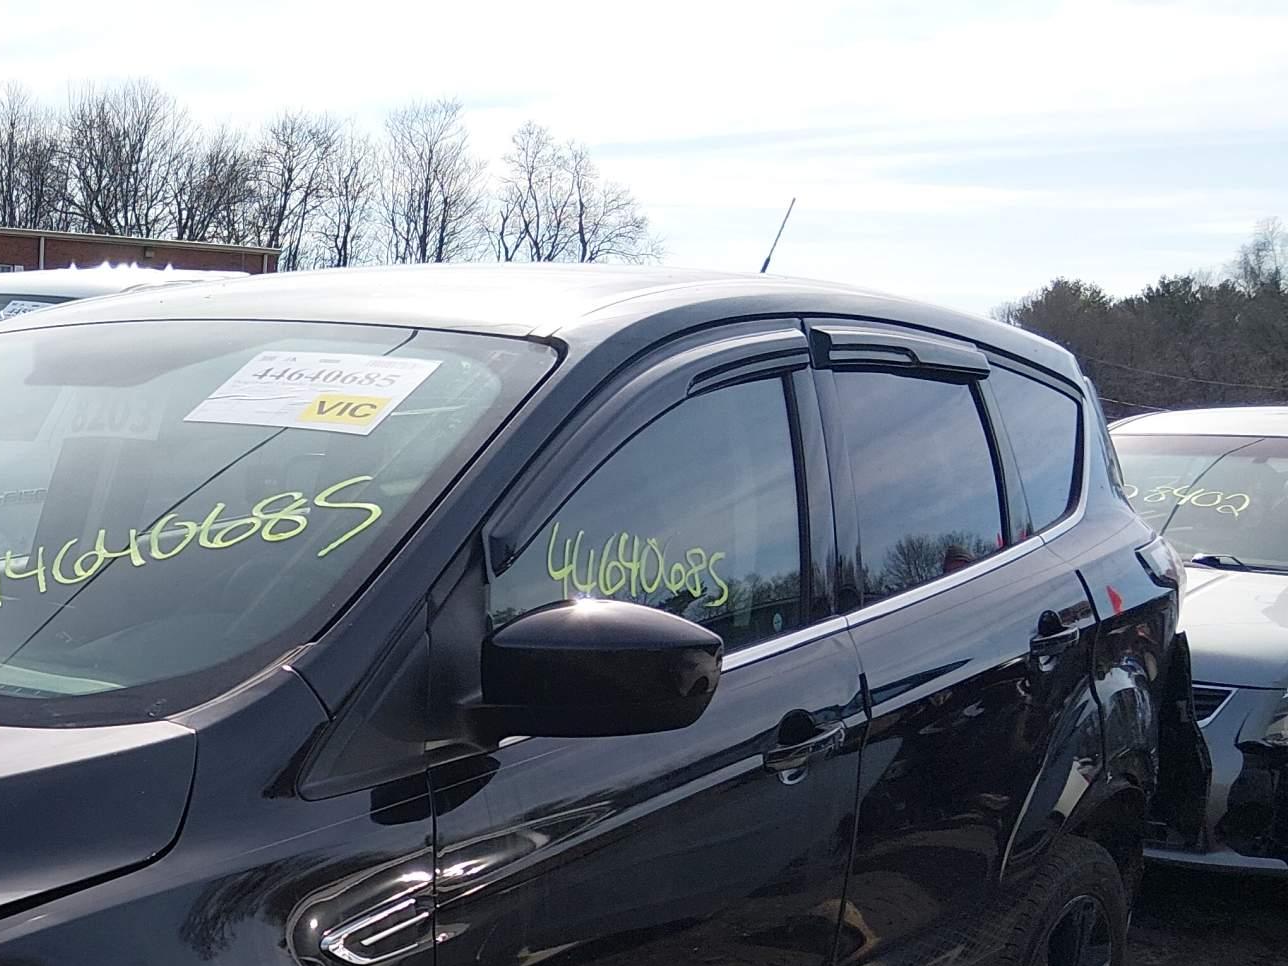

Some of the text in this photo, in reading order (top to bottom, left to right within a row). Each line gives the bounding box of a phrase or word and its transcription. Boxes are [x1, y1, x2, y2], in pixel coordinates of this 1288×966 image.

[252, 367, 401, 388] 44640685
[316, 400, 378, 419] VIC
[548, 522, 729, 607] 44640685
